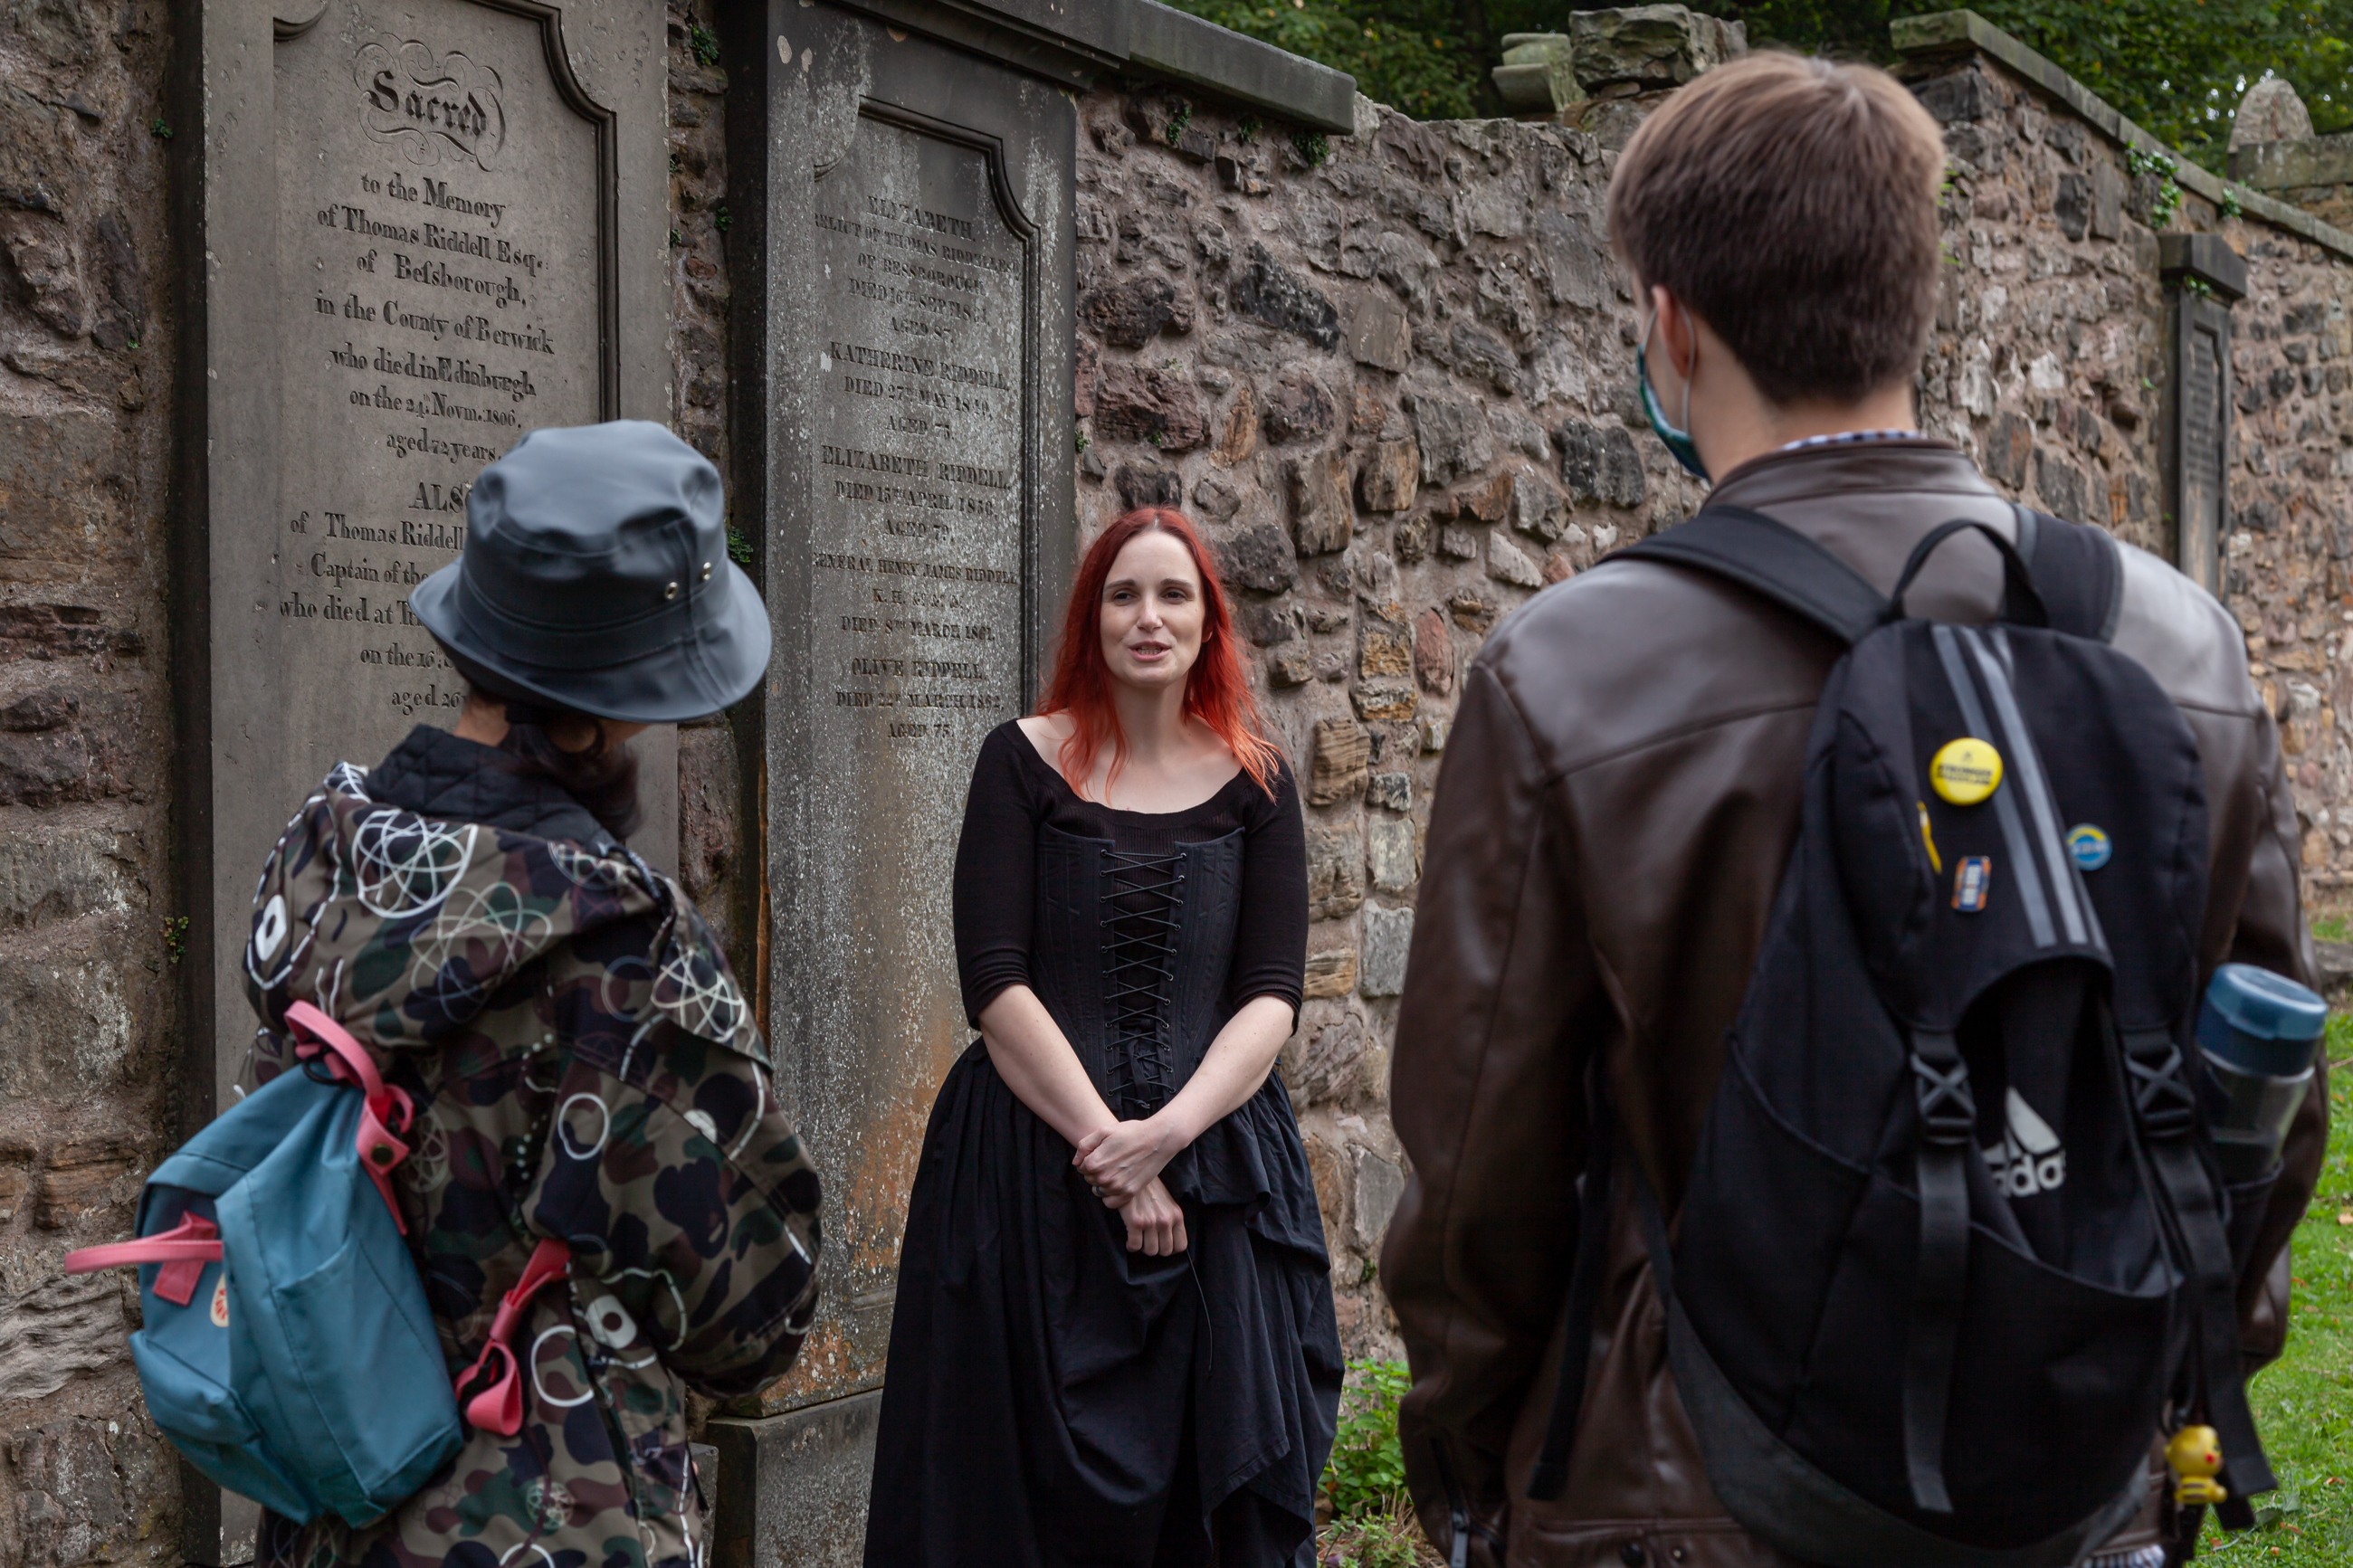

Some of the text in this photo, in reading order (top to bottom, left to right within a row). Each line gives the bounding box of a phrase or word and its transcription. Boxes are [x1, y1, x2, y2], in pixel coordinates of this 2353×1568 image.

[368, 71, 487, 137] Sacred
[361, 172, 506, 228] to the Memory
[318, 204, 338, 227] of
[342, 205, 419, 244] Thomas
[424, 223, 491, 261] Riddell
[865, 227, 881, 242] OF
[884, 231, 938, 257] THOMAS
[357, 249, 377, 273] of
[858, 252, 876, 271] OF
[849, 278, 888, 301] DIED
[315, 290, 555, 355] in the County of Berwick
[889, 317, 929, 337] AGED
[329, 341, 536, 403] who died in Edinburgh
[830, 341, 935, 377] KATHERINE
[350, 390, 370, 407] on
[373, 385, 402, 411] the
[844, 376, 884, 397] DIED
[919, 390, 950, 409] MAY
[886, 415, 928, 435] AGED
[386, 427, 429, 458] aged
[431, 439, 450, 456] 72
[821, 444, 929, 478] ELIZABETH
[408, 481, 472, 514] ALS
[834, 480, 873, 501] DIED
[905, 490, 954, 510] APRIL
[291, 511, 463, 550] of Thomas Riddell
[884, 518, 926, 538] AGED
[311, 552, 429, 589] Captain of the
[878, 559, 919, 576] HENRY
[923, 564, 962, 581] JAMES
[965, 567, 1017, 585] RIDDELL
[281, 592, 317, 618] who
[323, 594, 370, 622] died
[374, 604, 393, 625] at
[841, 615, 878, 632] DIED
[910, 621, 962, 639] MARCH
[360, 650, 382, 665] on
[386, 642, 414, 668] the
[852, 658, 904, 677] OLIVE
[392, 684, 438, 716] aged
[441, 692, 460, 708] 26
[835, 691, 873, 708] DIED
[908, 692, 965, 708] MARCH
[888, 723, 927, 738] AGED
